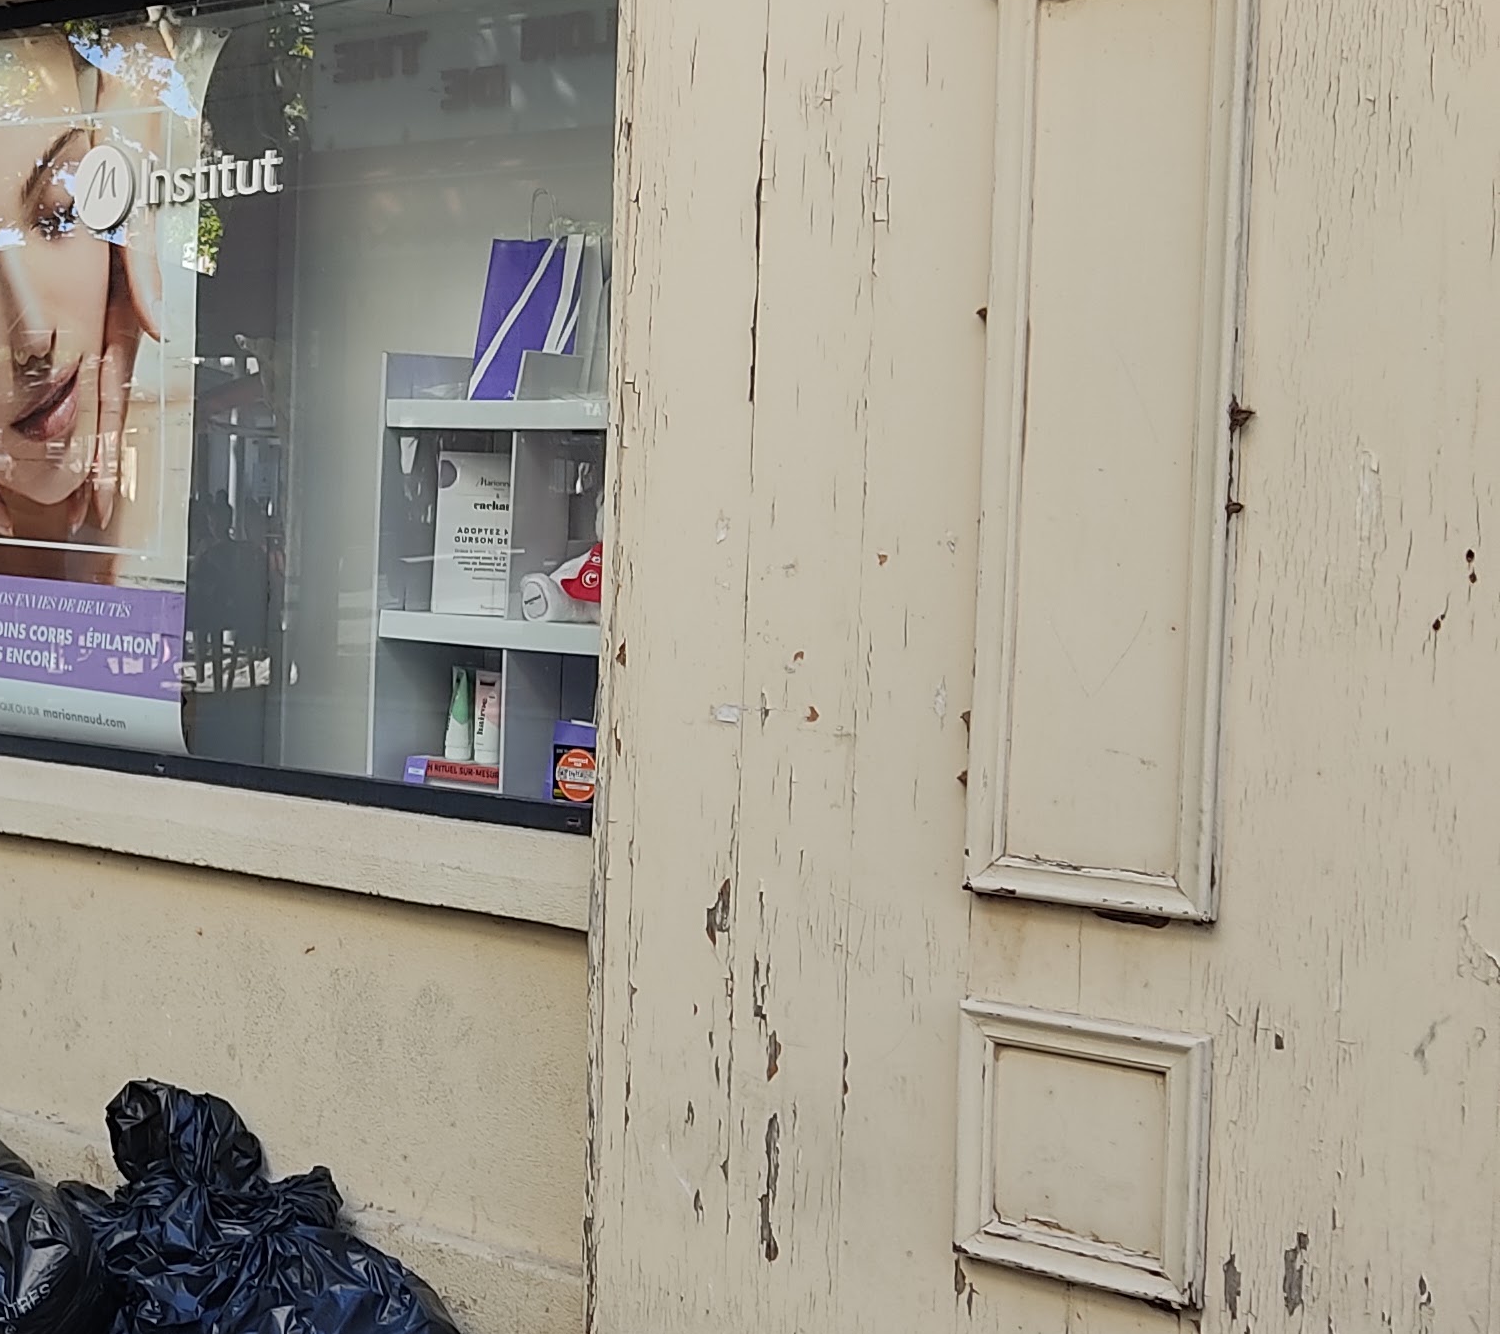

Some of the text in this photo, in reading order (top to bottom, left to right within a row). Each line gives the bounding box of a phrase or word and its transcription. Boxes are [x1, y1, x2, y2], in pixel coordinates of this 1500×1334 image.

[140, 149, 284, 208] Institut
[456, 526, 501, 536] ADOPTEZ
[454, 536, 494, 545] OURSON
[57, 597, 76, 613] DE
[29, 625, 73, 646] CORPS
[42, 707, 127, 730] marionnaud.com
